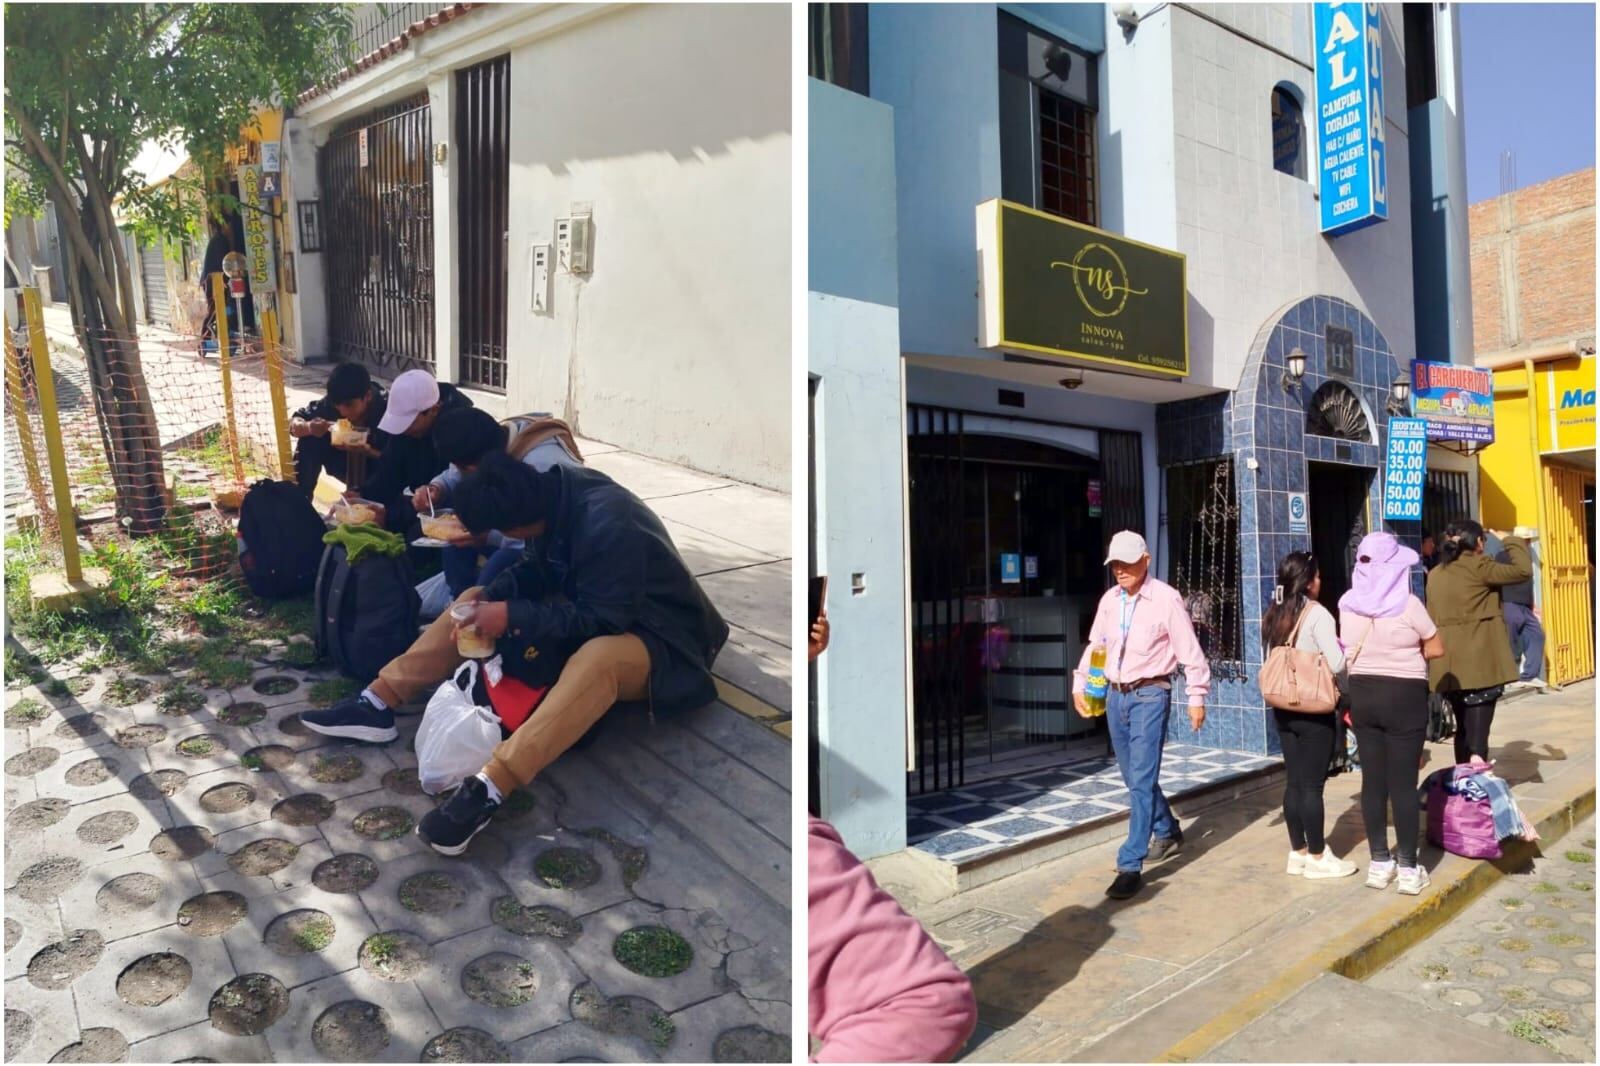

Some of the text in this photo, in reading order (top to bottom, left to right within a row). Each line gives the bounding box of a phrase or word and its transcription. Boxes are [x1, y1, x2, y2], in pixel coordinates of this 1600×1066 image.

[1323, 3, 1360, 91] AL
[1323, 88, 1362, 118] CAMPIÑA
[1326, 108, 1361, 135] DORADA
[1339, 143, 1364, 165] CALIENTE
[1332, 162, 1357, 184] TV CABLE
[243, 166, 269, 283] ABARROTES
[1081, 322, 1124, 341] INNOVA
[1415, 363, 1428, 390] EL
[1560, 388, 1596, 409] Ma
[1392, 421, 1425, 431] HOSTAL
[1390, 439, 1423, 455] 30.00
[1389, 455, 1423, 470] 35.00
[1388, 470, 1422, 485] 40.00
[1387, 485, 1421, 501] 50.00
[1386, 501, 1420, 516] 60.00
